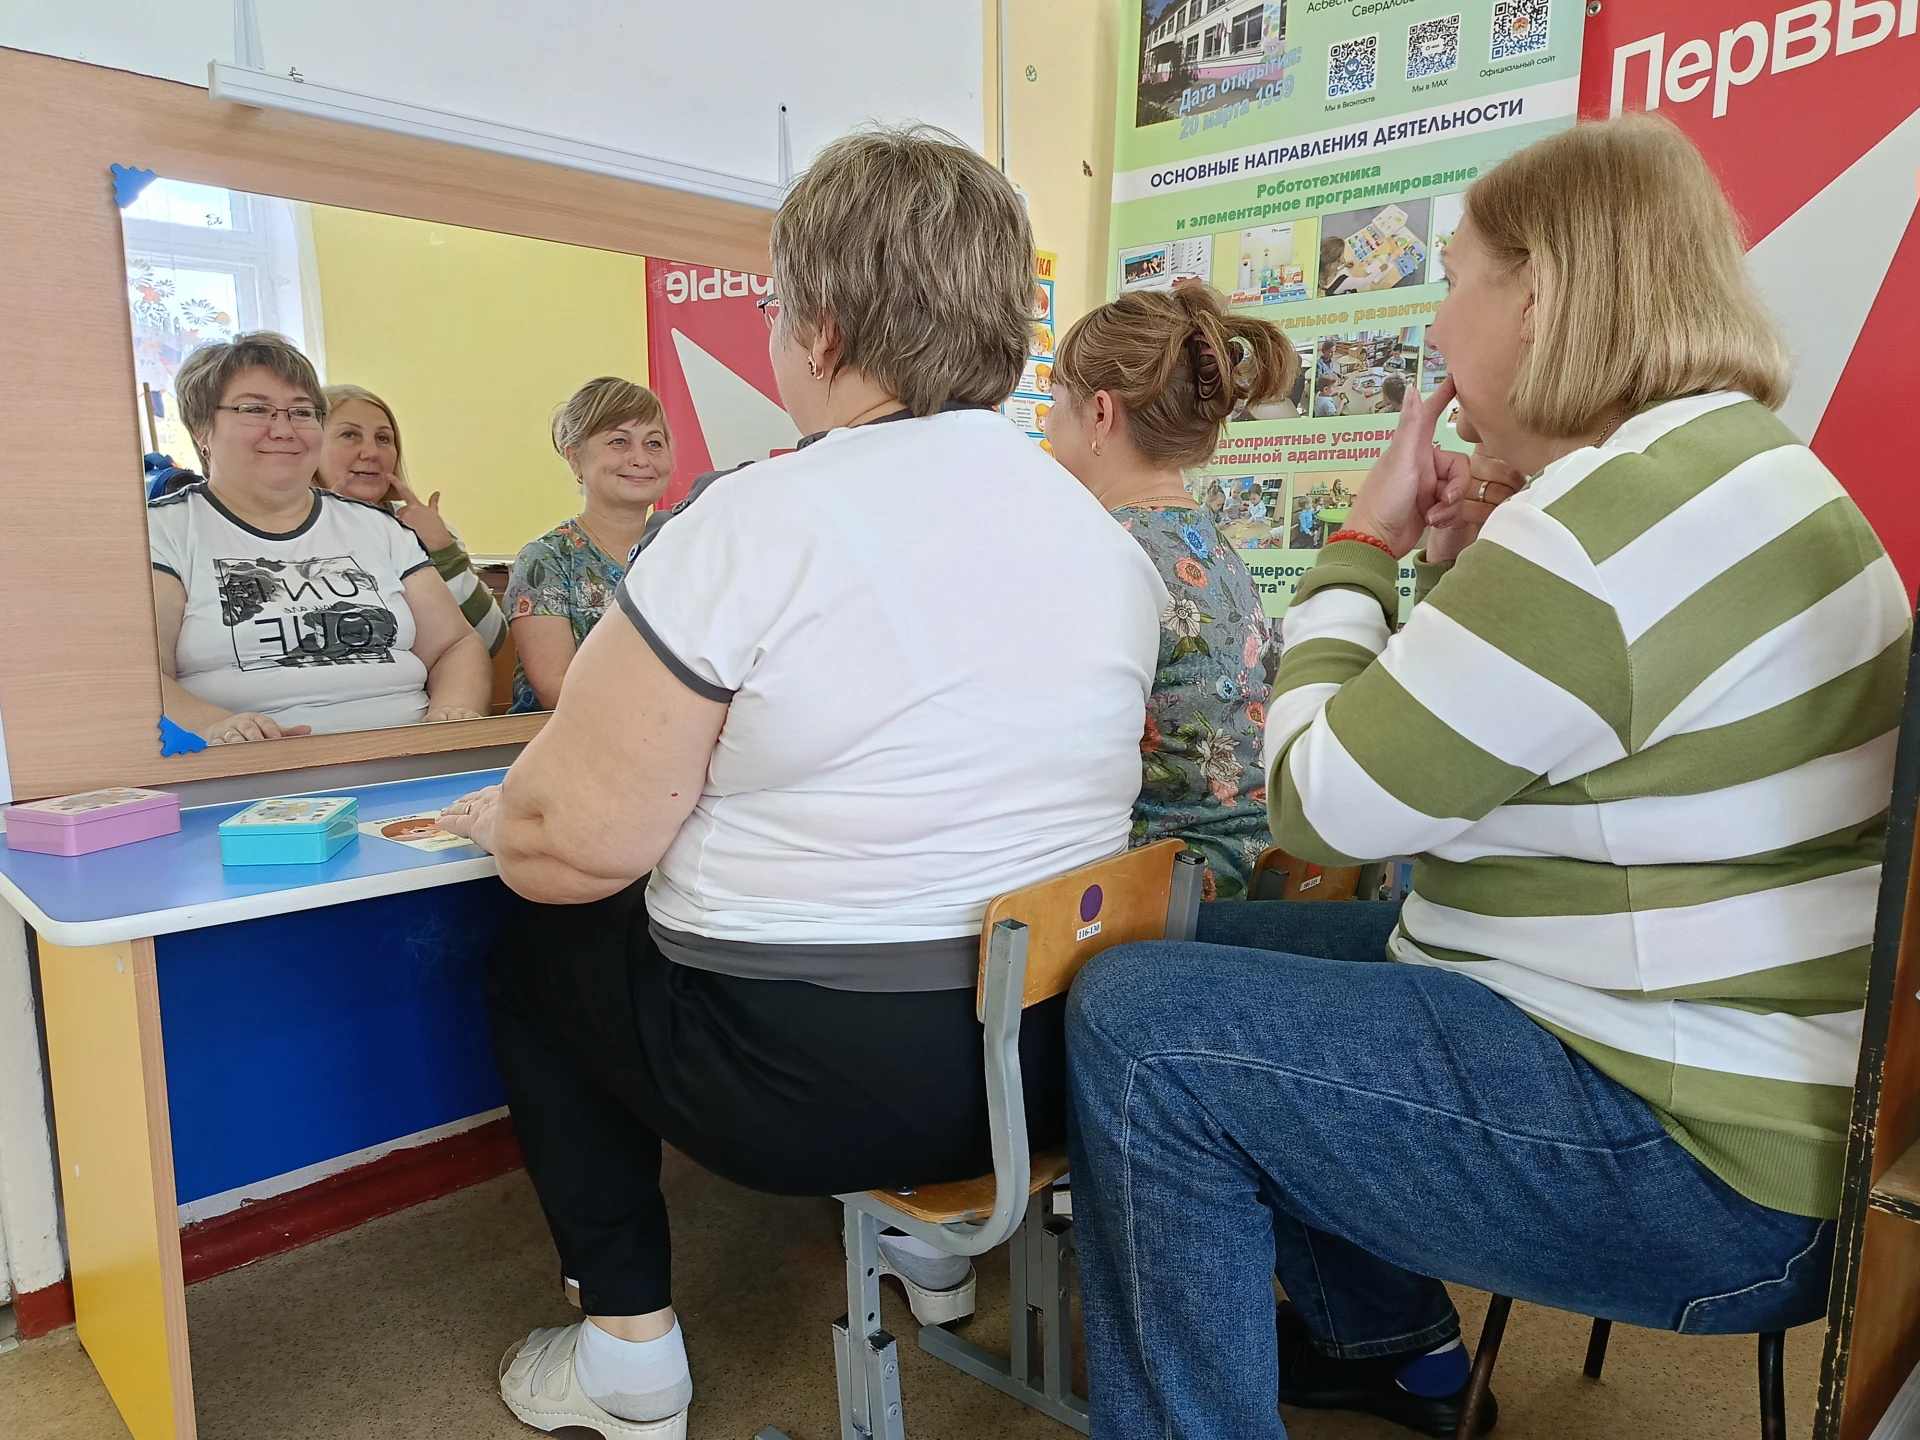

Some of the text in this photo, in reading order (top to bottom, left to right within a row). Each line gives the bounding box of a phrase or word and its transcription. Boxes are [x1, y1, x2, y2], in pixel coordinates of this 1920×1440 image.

[1306, 0, 1354, 14] Асбес
[1351, 0, 1418, 17] Свердлов
[1479, 55, 1556, 78] Официальный сайт
[1609, 0, 1920, 119] Первы
[1179, 46, 1302, 116] Дата открытия:
[1412, 84, 1425, 93] Мы
[1431, 78, 1449, 89] MAX
[1180, 74, 1295, 140] 20 марта 1959
[1342, 96, 1375, 109] Вконтакте
[1150, 98, 1524, 188] ОСНОВНЫЕ НАПРАВЛЕНИЯ ДЕЯТЕЛЬНОСТИ
[1257, 165, 1382, 198] Робототехника
[1176, 166, 1478, 230] и элементарное программирование
[1276, 300, 1443, 330] уальное развитие
[1218, 429, 1396, 450] агоприятные услови
[1210, 446, 1381, 465] спешной адаптации
